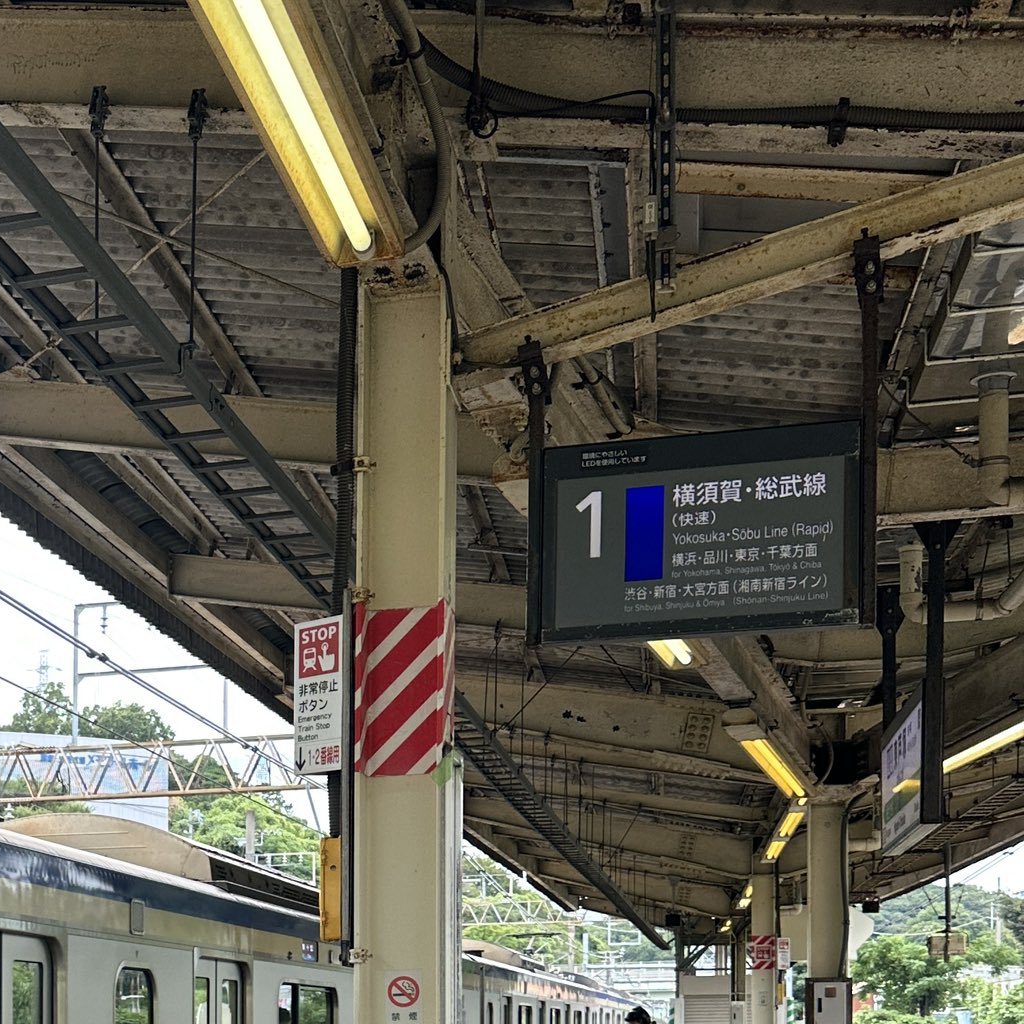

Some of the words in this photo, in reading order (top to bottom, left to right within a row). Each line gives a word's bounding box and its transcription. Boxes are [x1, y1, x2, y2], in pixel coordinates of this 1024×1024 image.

[672, 472, 827, 507] 横須賀・総武線
[575, 490, 602, 559] 1
[764, 525, 788, 538] Line
[791, 519, 834, 538] (Rapid)
[672, 542, 818, 567] 横浜・品川・東京・千葉方面
[671, 570, 681, 578] for
[792, 561, 798, 570] &
[800, 560, 822, 569] Chiba
[624, 605, 633, 613] for
[665, 600, 695, 611] Shinjuku
[695, 600, 701, 608] &
[807, 590, 829, 602] Line)
[301, 625, 337, 644] STOP
[298, 679, 339, 697] 非常停止
[298, 699, 329, 713] ボタン
[297, 712, 332, 724] Emergency
[297, 724, 314, 733] Train
[315, 722, 331, 731] Stop
[297, 733, 319, 743] Button
